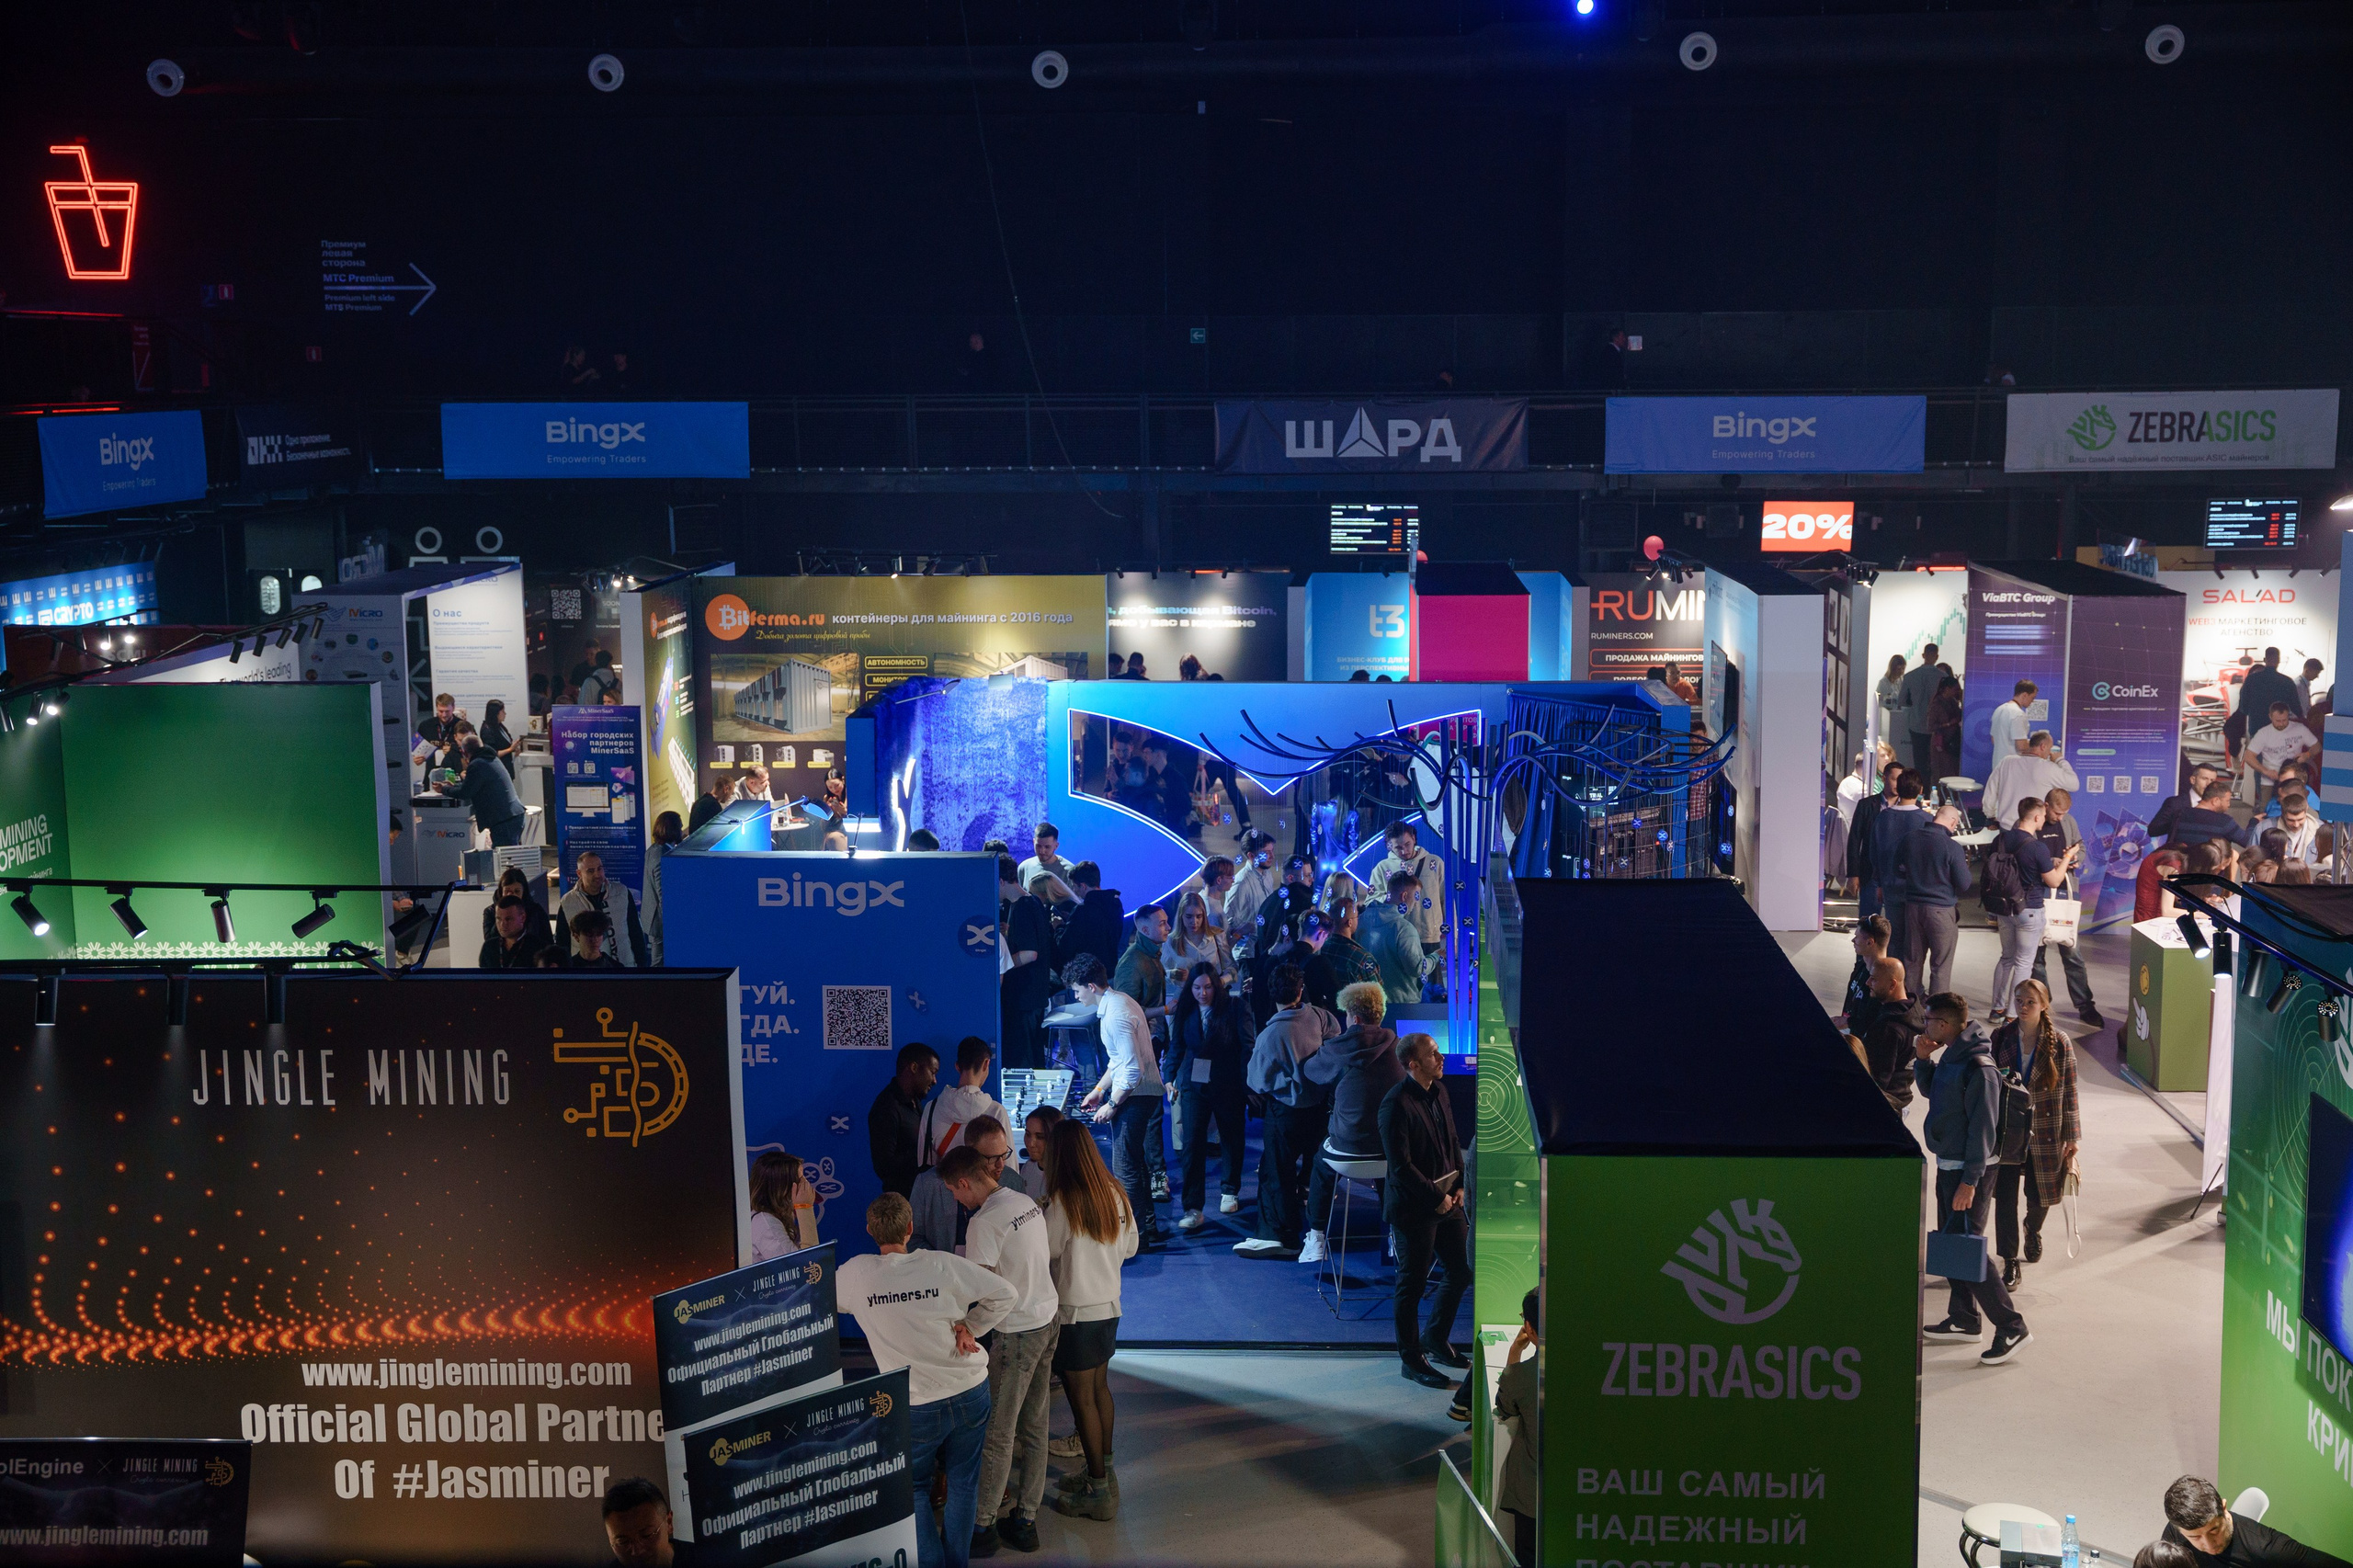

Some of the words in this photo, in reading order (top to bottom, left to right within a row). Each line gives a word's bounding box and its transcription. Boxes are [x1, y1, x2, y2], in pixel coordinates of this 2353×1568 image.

[321, 240, 367, 249] Премиум
[322, 260, 366, 268] сторона
[348, 274, 394, 283] Premium
[2127, 409, 2277, 443] ZEBRASICS
[547, 454, 607, 465] Empowering
[610, 454, 646, 463] Traders
[1712, 449, 1773, 460] Empowering
[1778, 449, 1815, 459] Traders
[1762, 513, 1853, 540] 20%
[1222, 606, 1277, 617] Bitcoin,
[1982, 593, 2020, 603] ViaBTC
[2023, 593, 2056, 605] Group
[53, 602, 95, 625] CRYPTO
[433, 608, 440, 618] О
[719, 604, 825, 631] Bitferma.ru
[832, 614, 908, 627] контейнеры
[911, 613, 934, 625] для
[938, 613, 996, 623] майнинга
[1000, 615, 1006, 623] с
[1010, 612, 1040, 623] 2016
[1044, 614, 1073, 624] года
[1191, 619, 1256, 629] кармане
[1591, 631, 1654, 641] RUMINERS.COM
[265, 663, 292, 679] leading
[1605, 653, 1648, 664] ПРОДАЖА
[2112, 685, 2159, 699] CoinEx
[590, 746, 634, 755] MinerSaaS
[0, 813, 48, 850] MINING
[193, 1049, 335, 1106] JINGLE
[369, 1049, 512, 1106] MINING
[753, 1275, 775, 1292] JINGLE
[867, 1287, 939, 1307] ytminers.ru
[675, 1294, 725, 1324] JASMINER
[694, 1301, 812, 1352] www.jinglemining.com
[2266, 1289, 2301, 1361] МЫ
[667, 1337, 760, 1383] Официальный
[761, 1313, 834, 1352] Глобальный
[302, 1358, 631, 1390] www.jinglemining.com
[701, 1367, 753, 1397] Партнер
[753, 1346, 813, 1381] #Jasminer
[1600, 1342, 1862, 1401] ZEBRASICS
[241, 1403, 387, 1444] Official
[396, 1403, 528, 1444] Global
[806, 1404, 834, 1427] JINGLE
[837, 1397, 866, 1421] MINING
[122, 1458, 157, 1473] JINGLE
[733, 1440, 878, 1500] www.jinglemining.com
[334, 1459, 375, 1498] Of
[392, 1460, 609, 1500] #Jasminer
[1576, 1467, 1664, 1496] ВАШ
[1677, 1467, 1826, 1500] САМЫЙ
[702, 1481, 814, 1537] Официальный
[815, 1451, 906, 1499] Глобальный
[740, 1517, 802, 1551] Партнер
[803, 1488, 880, 1532] #Jasminer
[1575, 1513, 1807, 1547] НАДЕЖНЫЙ
